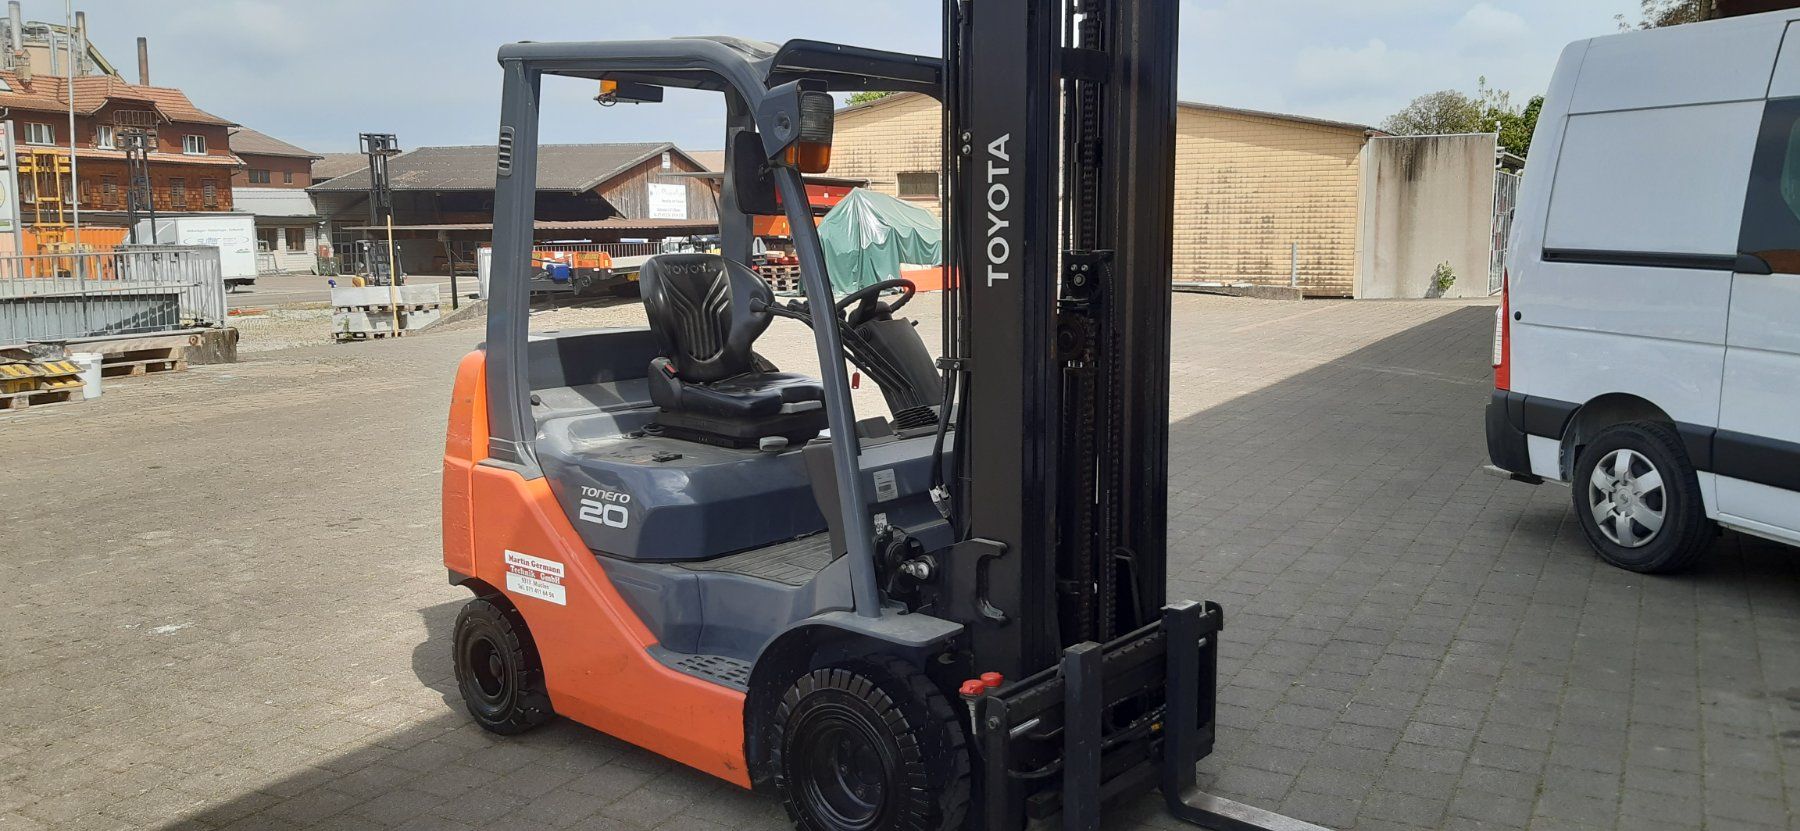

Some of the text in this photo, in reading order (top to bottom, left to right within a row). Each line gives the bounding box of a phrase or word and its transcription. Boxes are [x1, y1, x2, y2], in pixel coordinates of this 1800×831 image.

[987, 133, 1010, 287] TOYOTA
[579, 498, 629, 529] 20
[508, 554, 561, 574] Martin Germann
[510, 565, 560, 585] Technik GmbH
